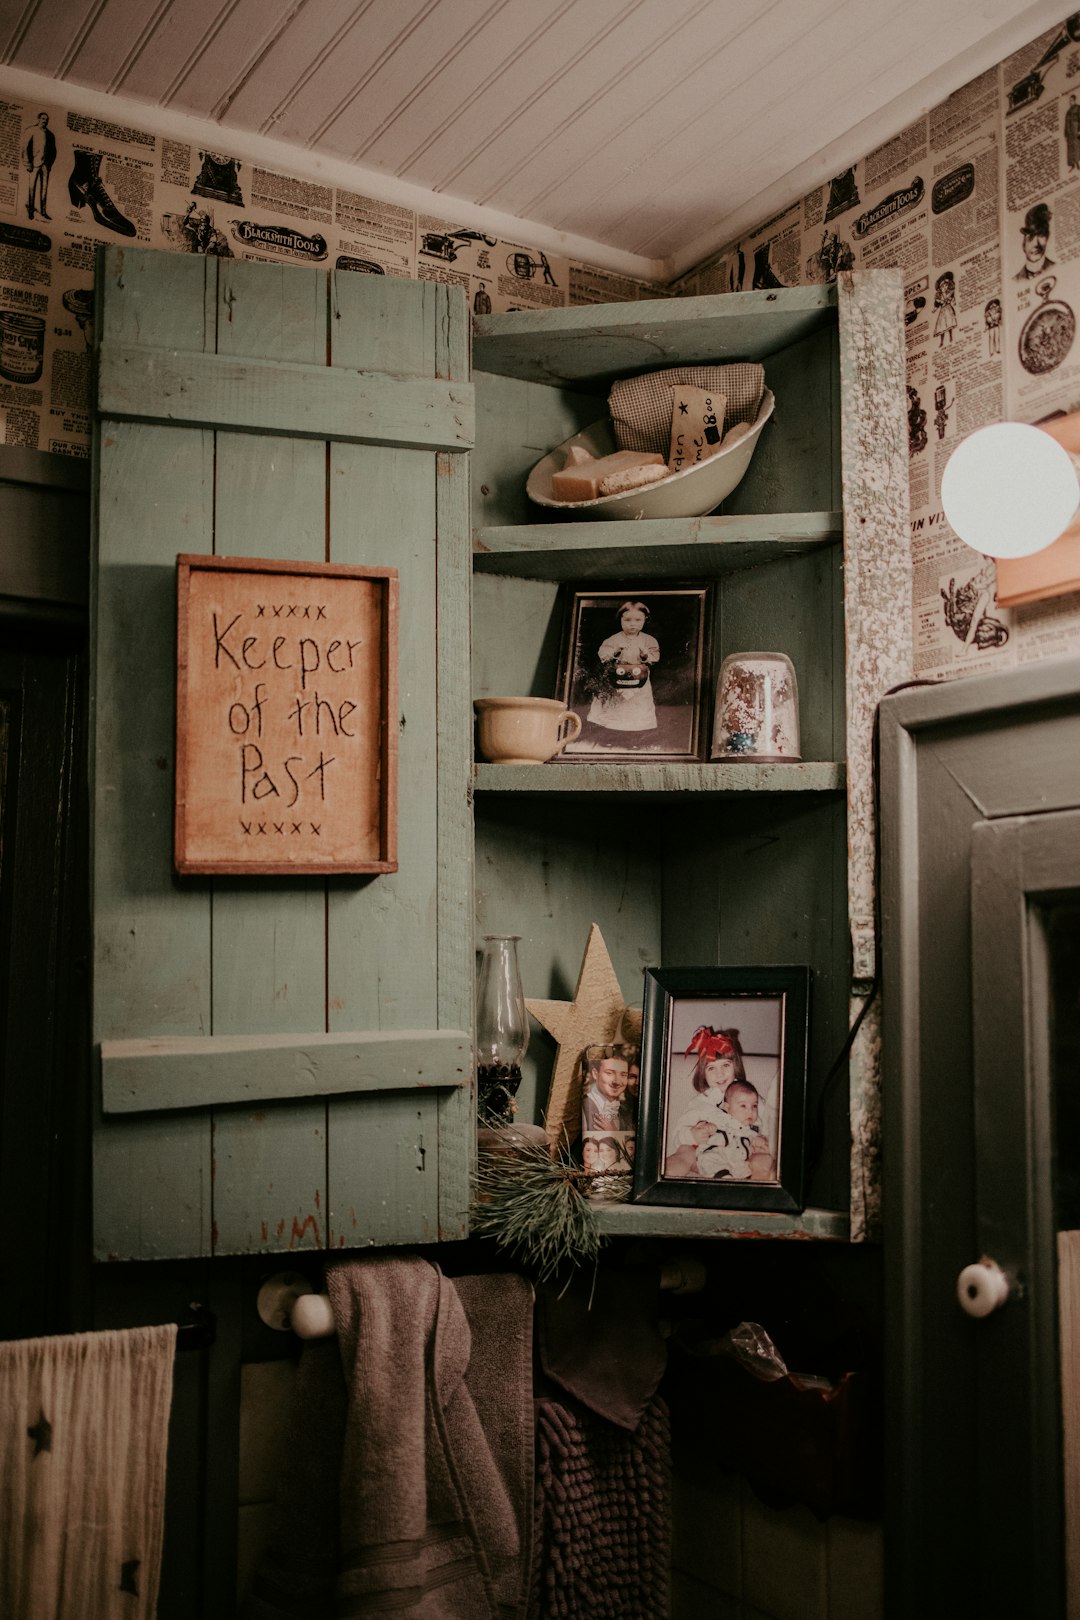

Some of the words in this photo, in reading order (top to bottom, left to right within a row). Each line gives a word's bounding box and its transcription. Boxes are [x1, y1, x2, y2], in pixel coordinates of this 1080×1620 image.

[99, 150, 121, 160] DOUBLE
[124, 156, 154, 168] STITCHED
[894, 189, 918, 209] TOOLS
[242, 224, 293, 247] BLACKSMITH
[290, 233, 320, 253] TOOLS
[2, 286, 24, 298] CREAM
[24, 290, 32, 302] OR
[33, 293, 49, 304] FOOD
[52, 441, 68, 449] OUR
[212, 612, 363, 690] Keeper
[228, 683, 268, 738] of
[287, 691, 358, 737] the
